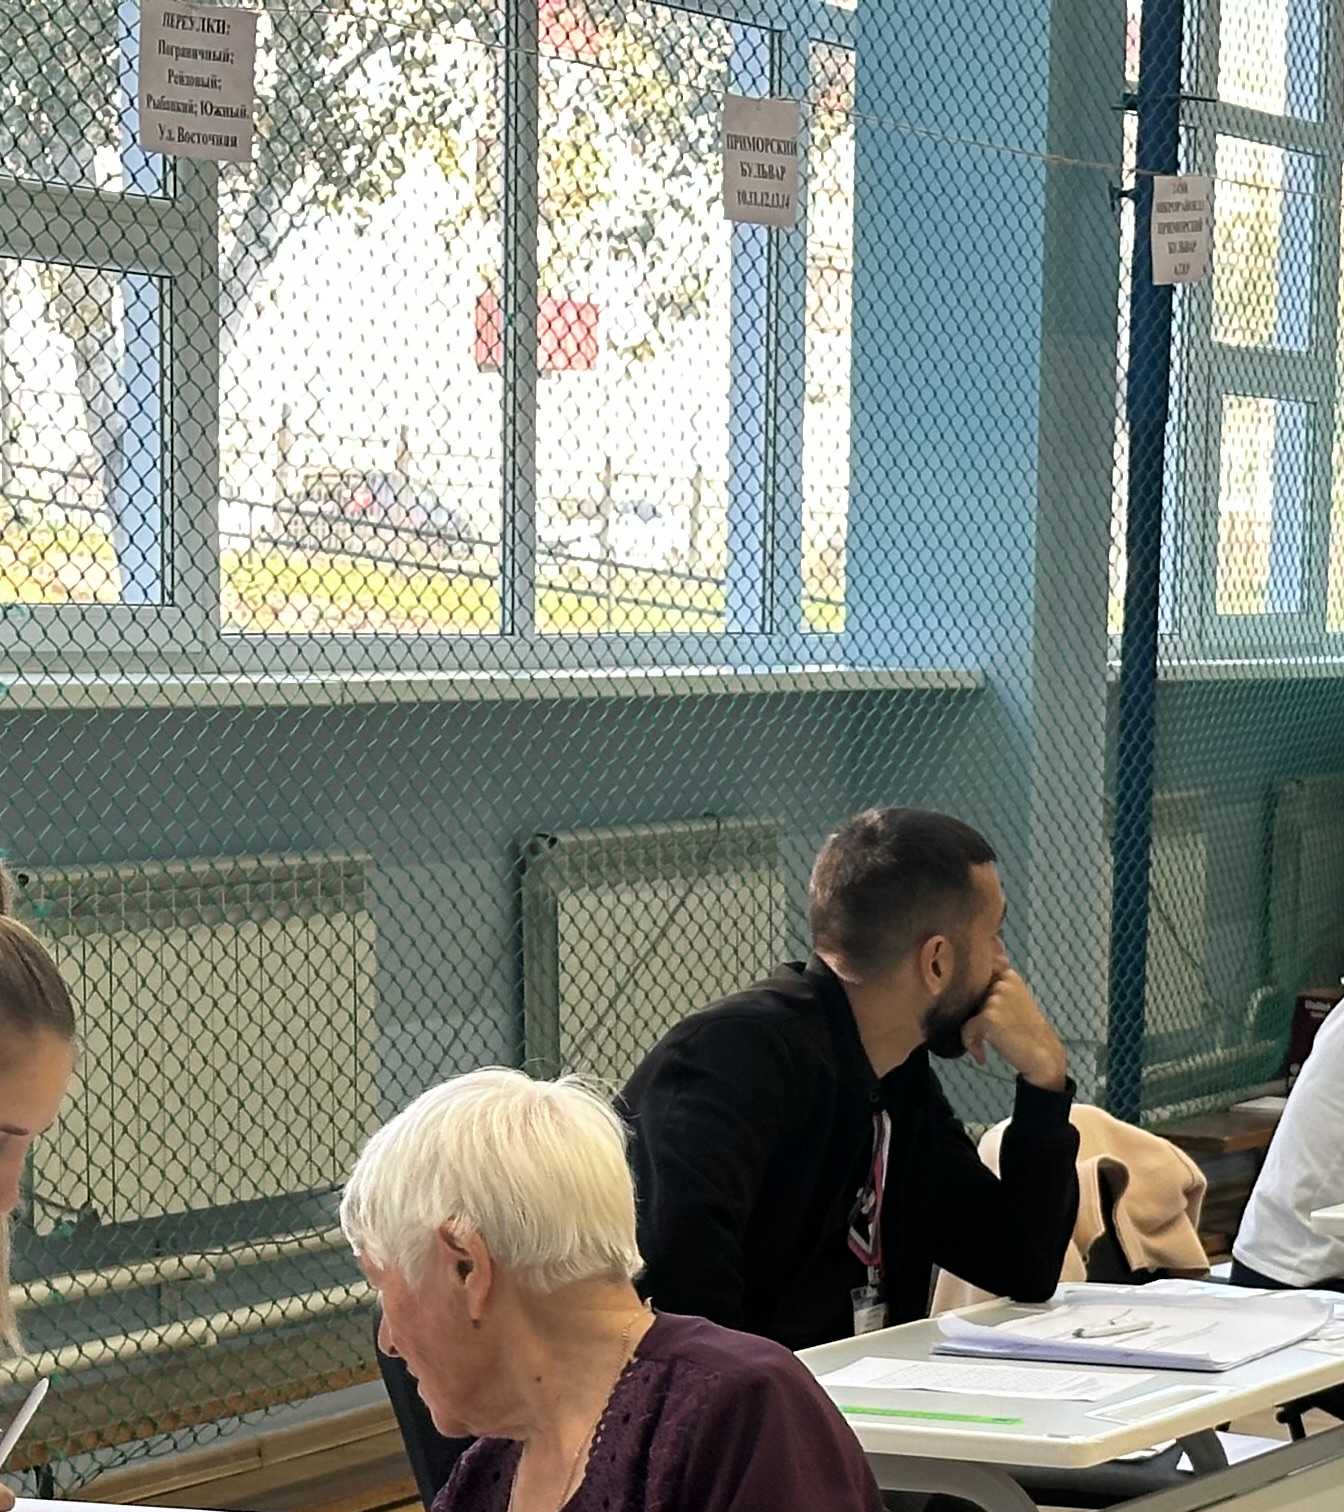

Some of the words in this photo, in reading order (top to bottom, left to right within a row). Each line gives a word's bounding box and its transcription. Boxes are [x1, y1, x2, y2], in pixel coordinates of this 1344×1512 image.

[162, 11, 231, 36] ПЕРЕУЛКИ:
[177, 126, 238, 148] Восточная
[726, 133, 798, 157] ПРИМОРСКИЙ
[739, 161, 786, 182] БУЛЬВАР
